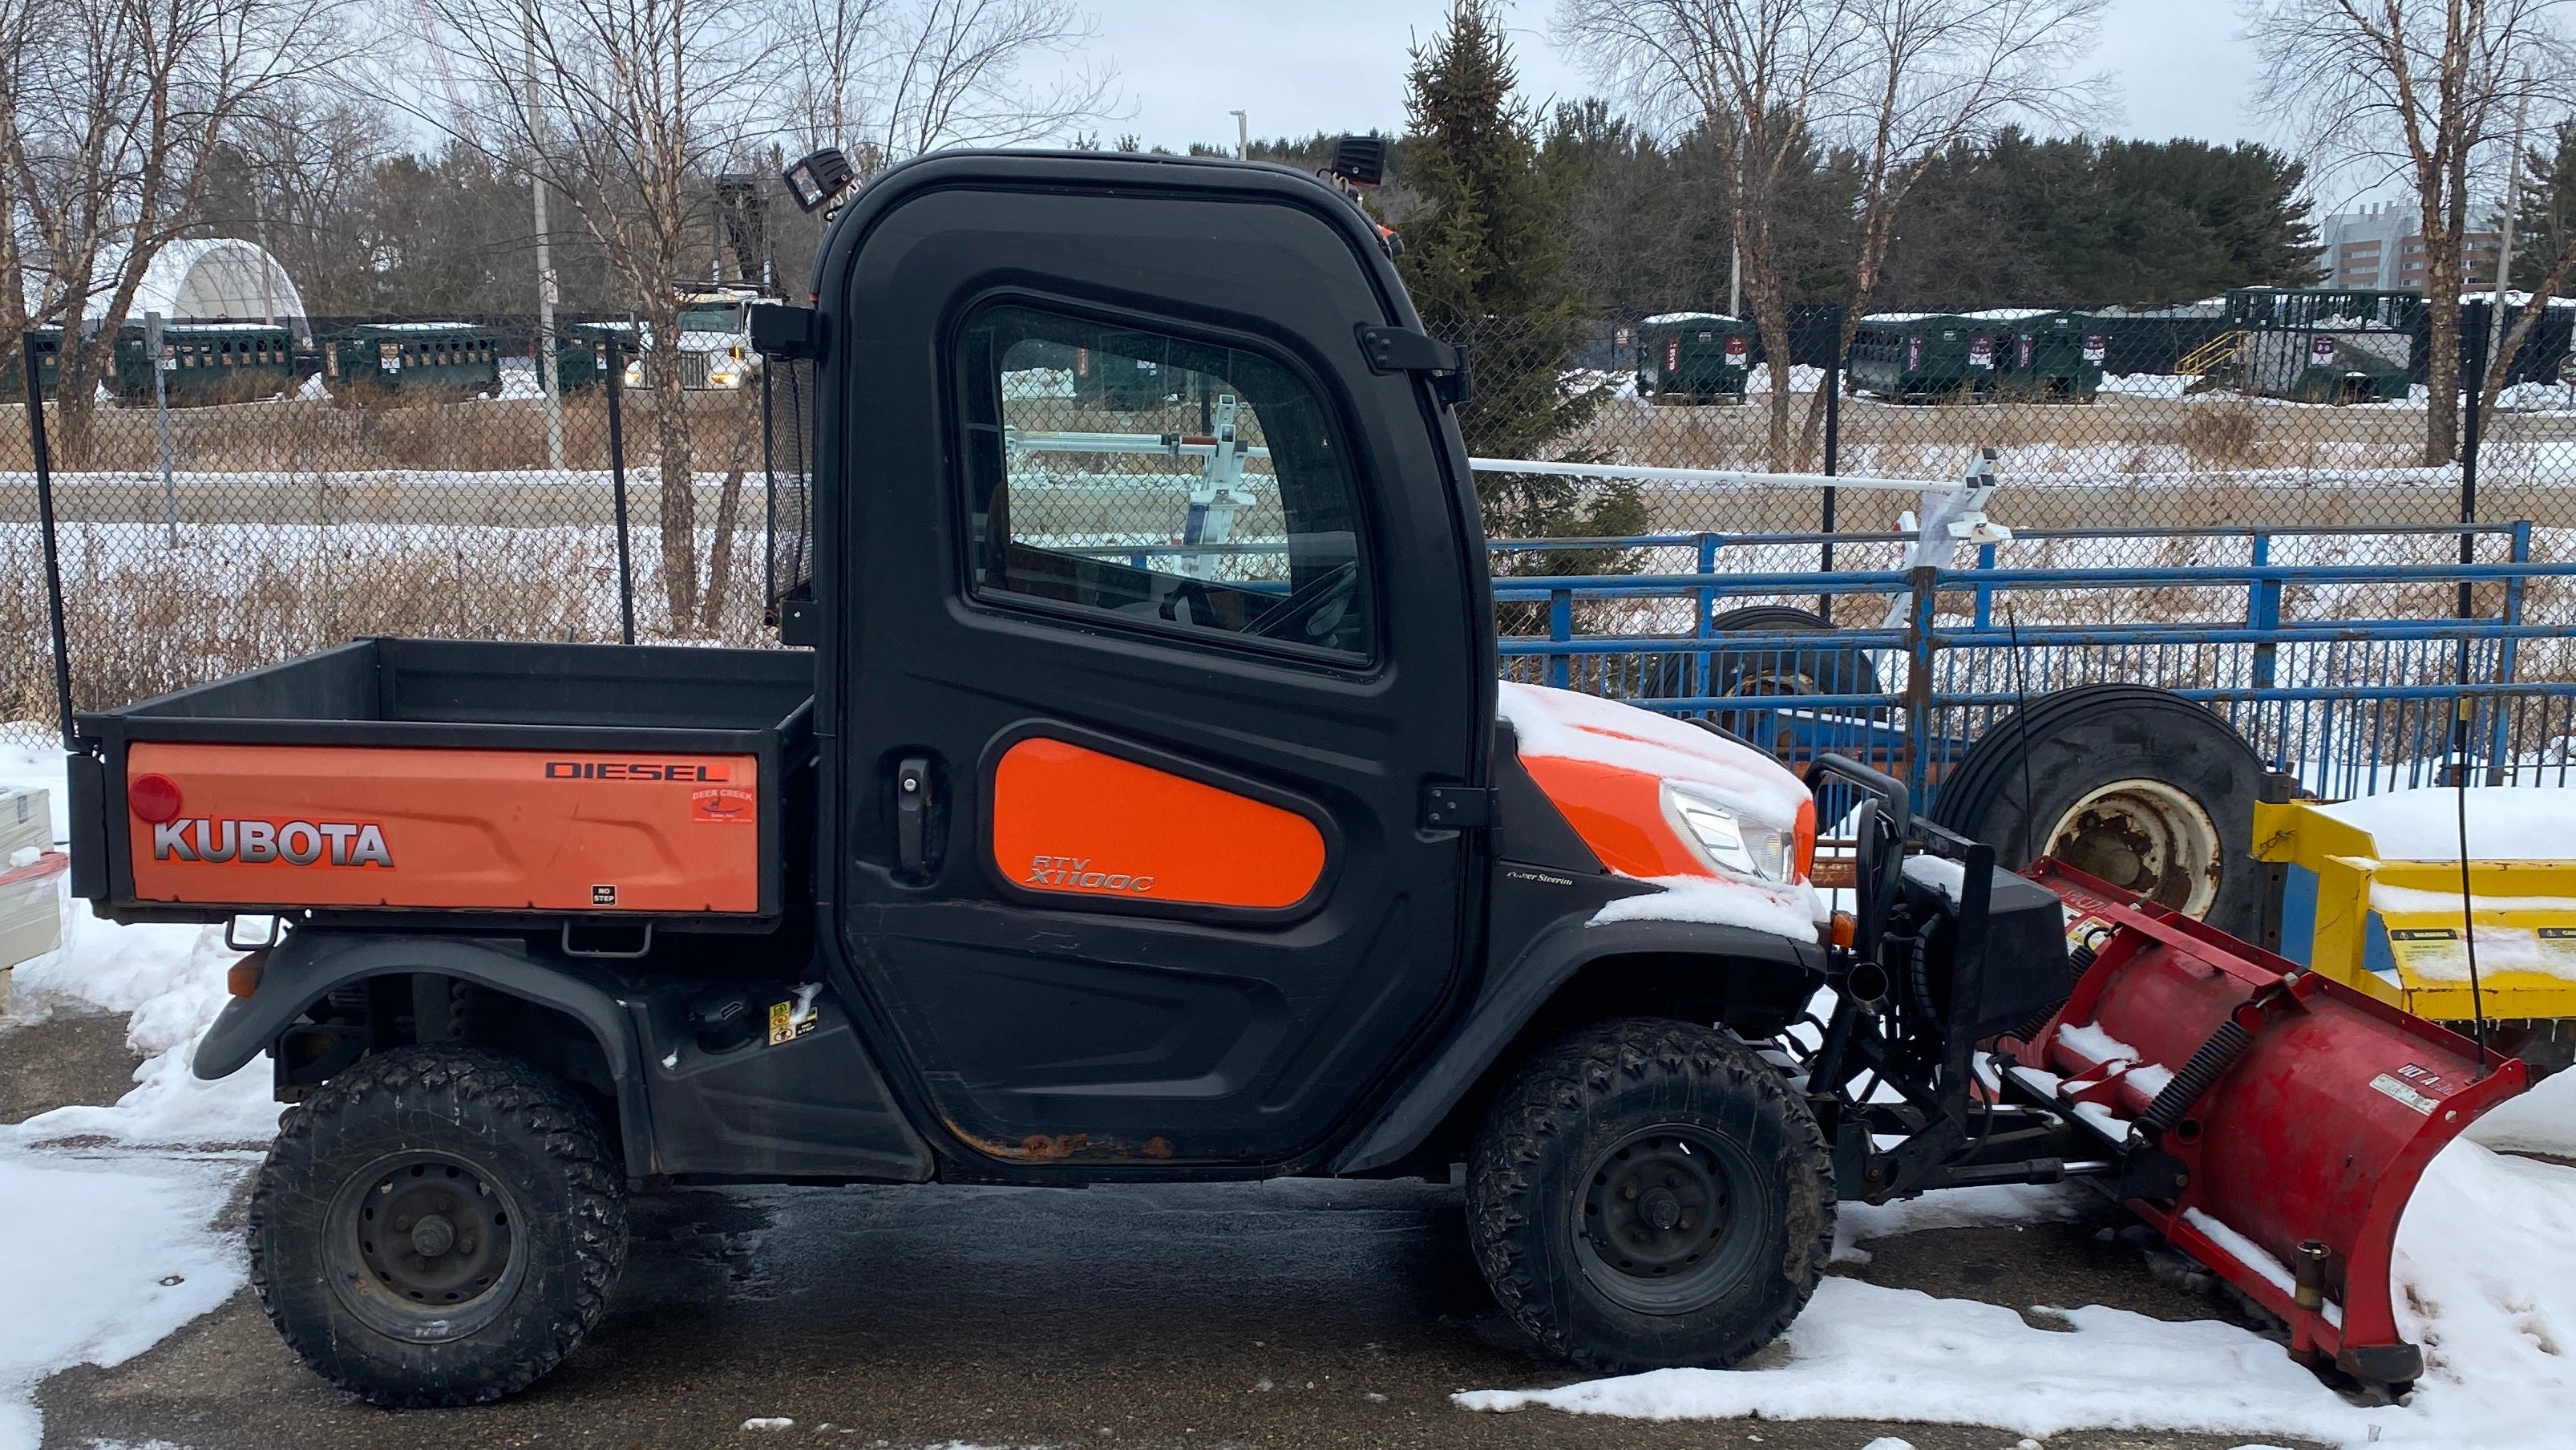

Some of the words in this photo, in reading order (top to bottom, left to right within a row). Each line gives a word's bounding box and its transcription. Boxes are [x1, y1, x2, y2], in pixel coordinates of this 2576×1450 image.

[546, 763, 728, 782] DIESEL
[693, 789, 718, 800] DEER
[720, 789, 753, 801] CREEK
[154, 818, 394, 867] KUBOTA
[1031, 855, 1090, 870] RTV
[1025, 868, 1155, 892] X1100C
